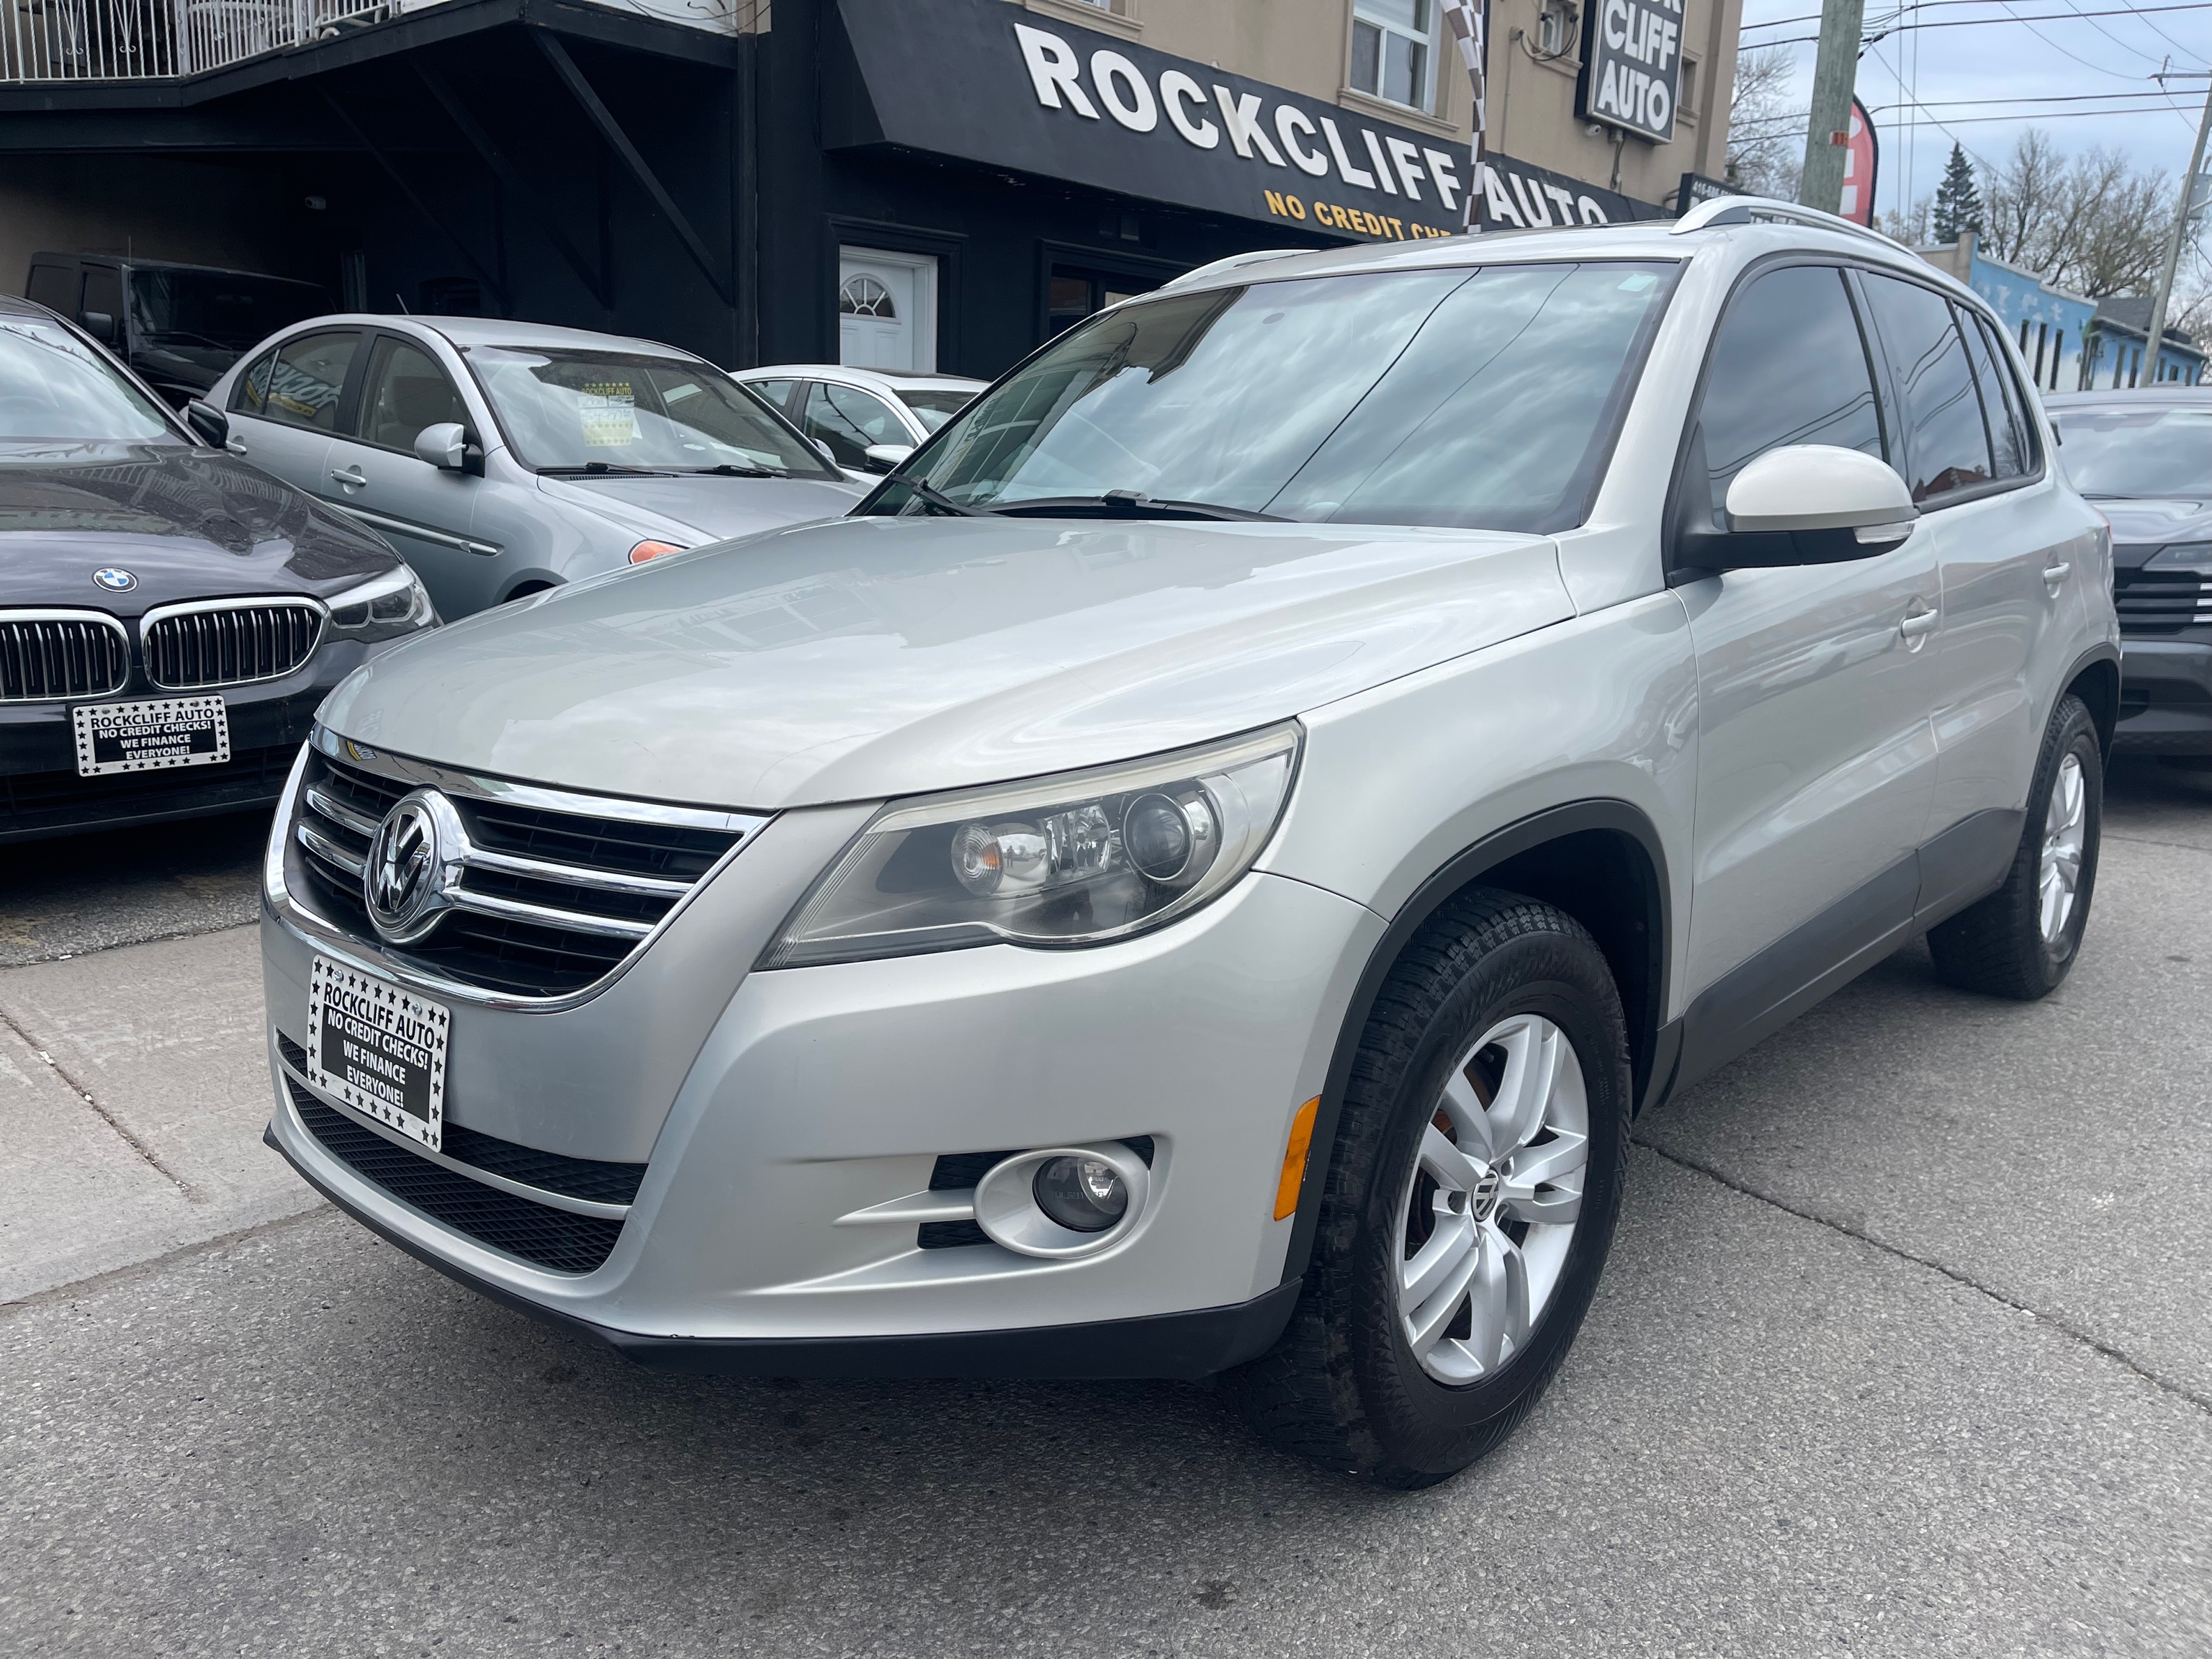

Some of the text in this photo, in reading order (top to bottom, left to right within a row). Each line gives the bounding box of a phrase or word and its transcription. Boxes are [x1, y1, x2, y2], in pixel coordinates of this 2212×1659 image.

[1604, 0, 1678, 71] CLIFF
[1014, 22, 1462, 211] ROCKCLIFF
[1597, 59, 1671, 131] AUTO
[1264, 189, 1306, 220] NO
[1313, 201, 1404, 240] CREDIT
[91, 709, 215, 729] ROCKCLIFF AUTO
[99, 721, 212, 739] NO CREDIT CHECKS!
[120, 734, 192, 749] WE FINANCE
[126, 746, 190, 760] EVERYONE!
[324, 982, 434, 1049] ROCKCLIFF AUTO
[328, 1009, 428, 1070] NO CREDIT CHECKS!
[343, 1039, 405, 1085] WE FINANCE
[347, 1064, 404, 1108] EVERYONE!
